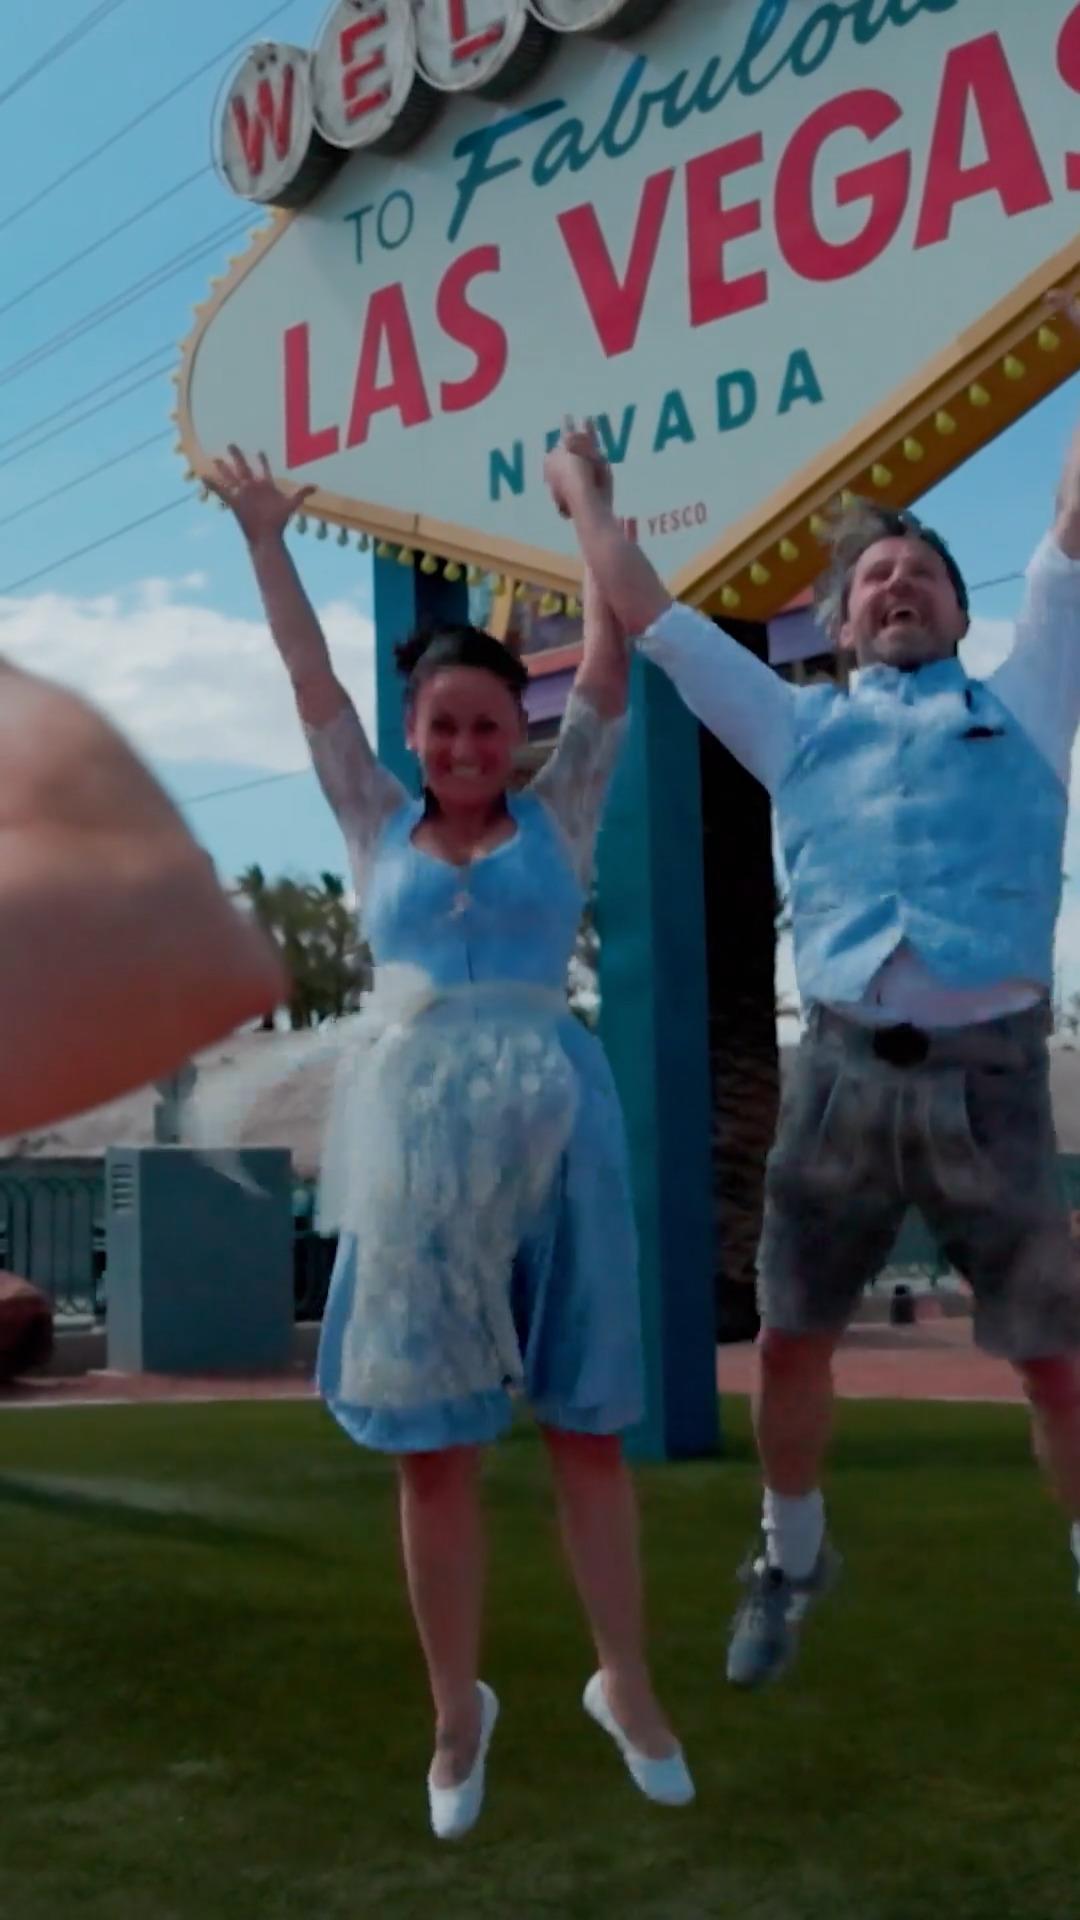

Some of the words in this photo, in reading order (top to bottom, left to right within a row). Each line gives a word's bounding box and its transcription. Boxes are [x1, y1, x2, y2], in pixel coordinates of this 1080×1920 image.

[284, 243, 508, 470] LAS
[556, 0, 1080, 358] VEGA
[343, 190, 414, 265] TO
[447, 0, 957, 243] Fabulou
[489, 347, 824, 501] NVADA
[648, 501, 707, 536] YESCO
